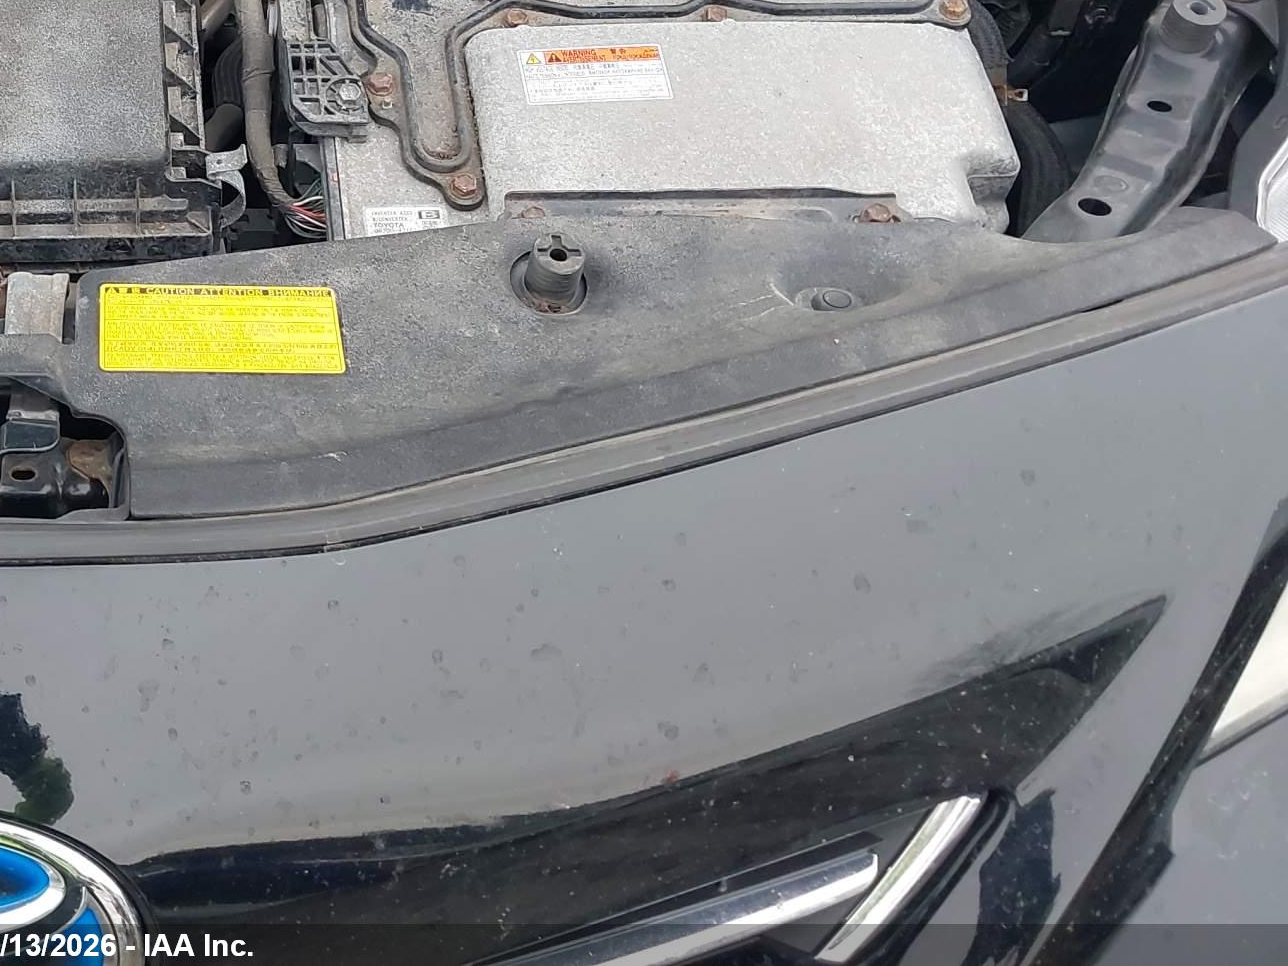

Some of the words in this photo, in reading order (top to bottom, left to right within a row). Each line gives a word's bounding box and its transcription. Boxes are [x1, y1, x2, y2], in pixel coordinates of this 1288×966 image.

[562, 49, 597, 57] WARNING
[145, 287, 195, 295] CAUTION
[199, 288, 263, 296] ATTENTION
[269, 289, 330, 297] ВНИМАНИЕ
